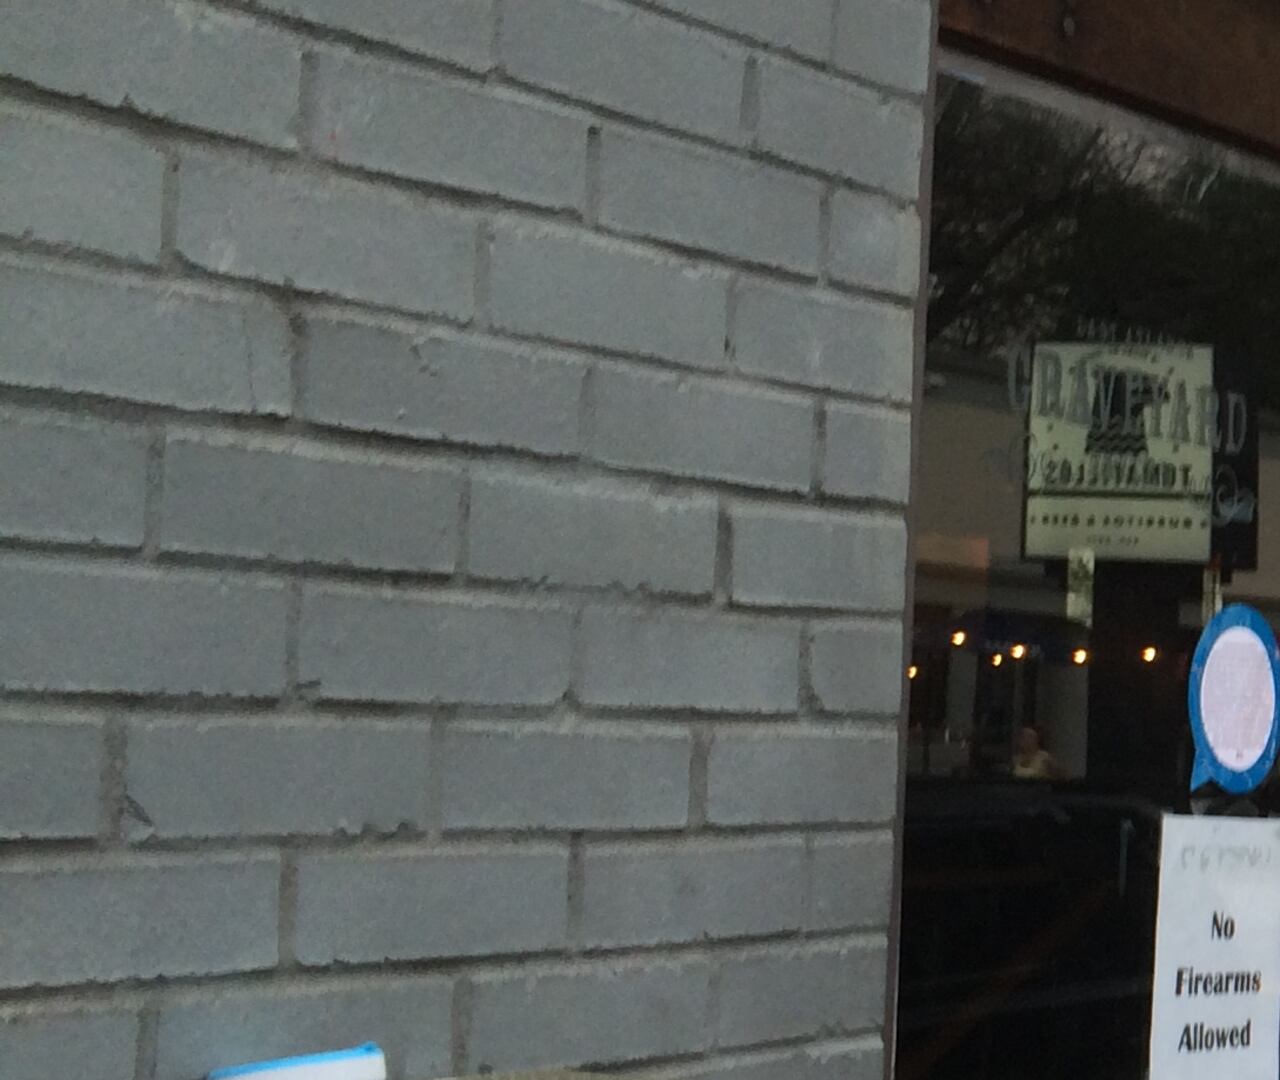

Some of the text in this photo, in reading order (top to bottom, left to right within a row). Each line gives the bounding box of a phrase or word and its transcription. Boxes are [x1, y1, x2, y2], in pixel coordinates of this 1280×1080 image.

[1007, 345, 1248, 456] GRAVEYARD
[1211, 910, 1235, 940] No
[1175, 967, 1262, 997] Firearms
[1178, 1020, 1251, 1053] Allowed
